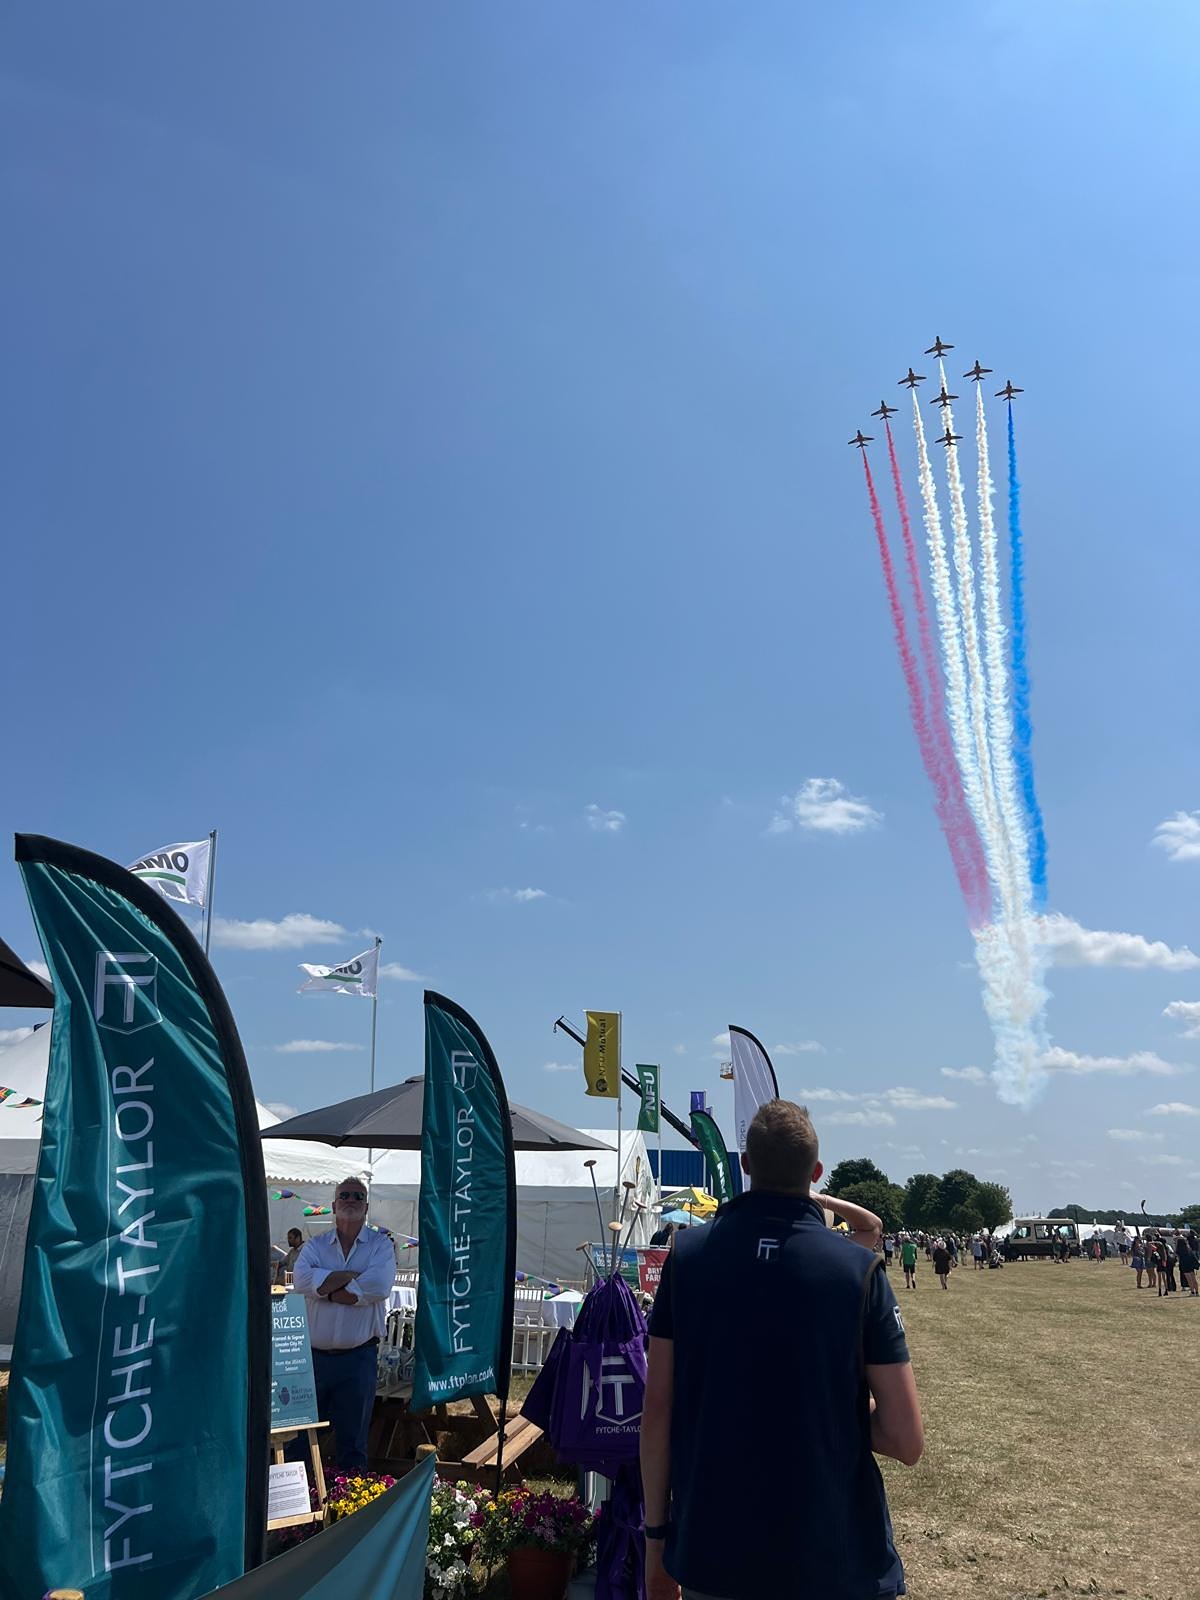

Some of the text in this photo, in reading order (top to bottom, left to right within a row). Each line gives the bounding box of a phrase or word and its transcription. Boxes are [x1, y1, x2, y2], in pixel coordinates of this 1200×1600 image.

[643, 1071, 656, 1111] NFU
[451, 1104, 475, 1354] FYTCHE-TAYLOR
[104, 1057, 160, 1572] FYTCHE-TAYLOR
[273, 1316, 305, 1329] RIZES!
[428, 1366, 495, 1392] www.ftplan.co.uk
[595, 1425, 641, 1435] FYTCHE-TAYLO
